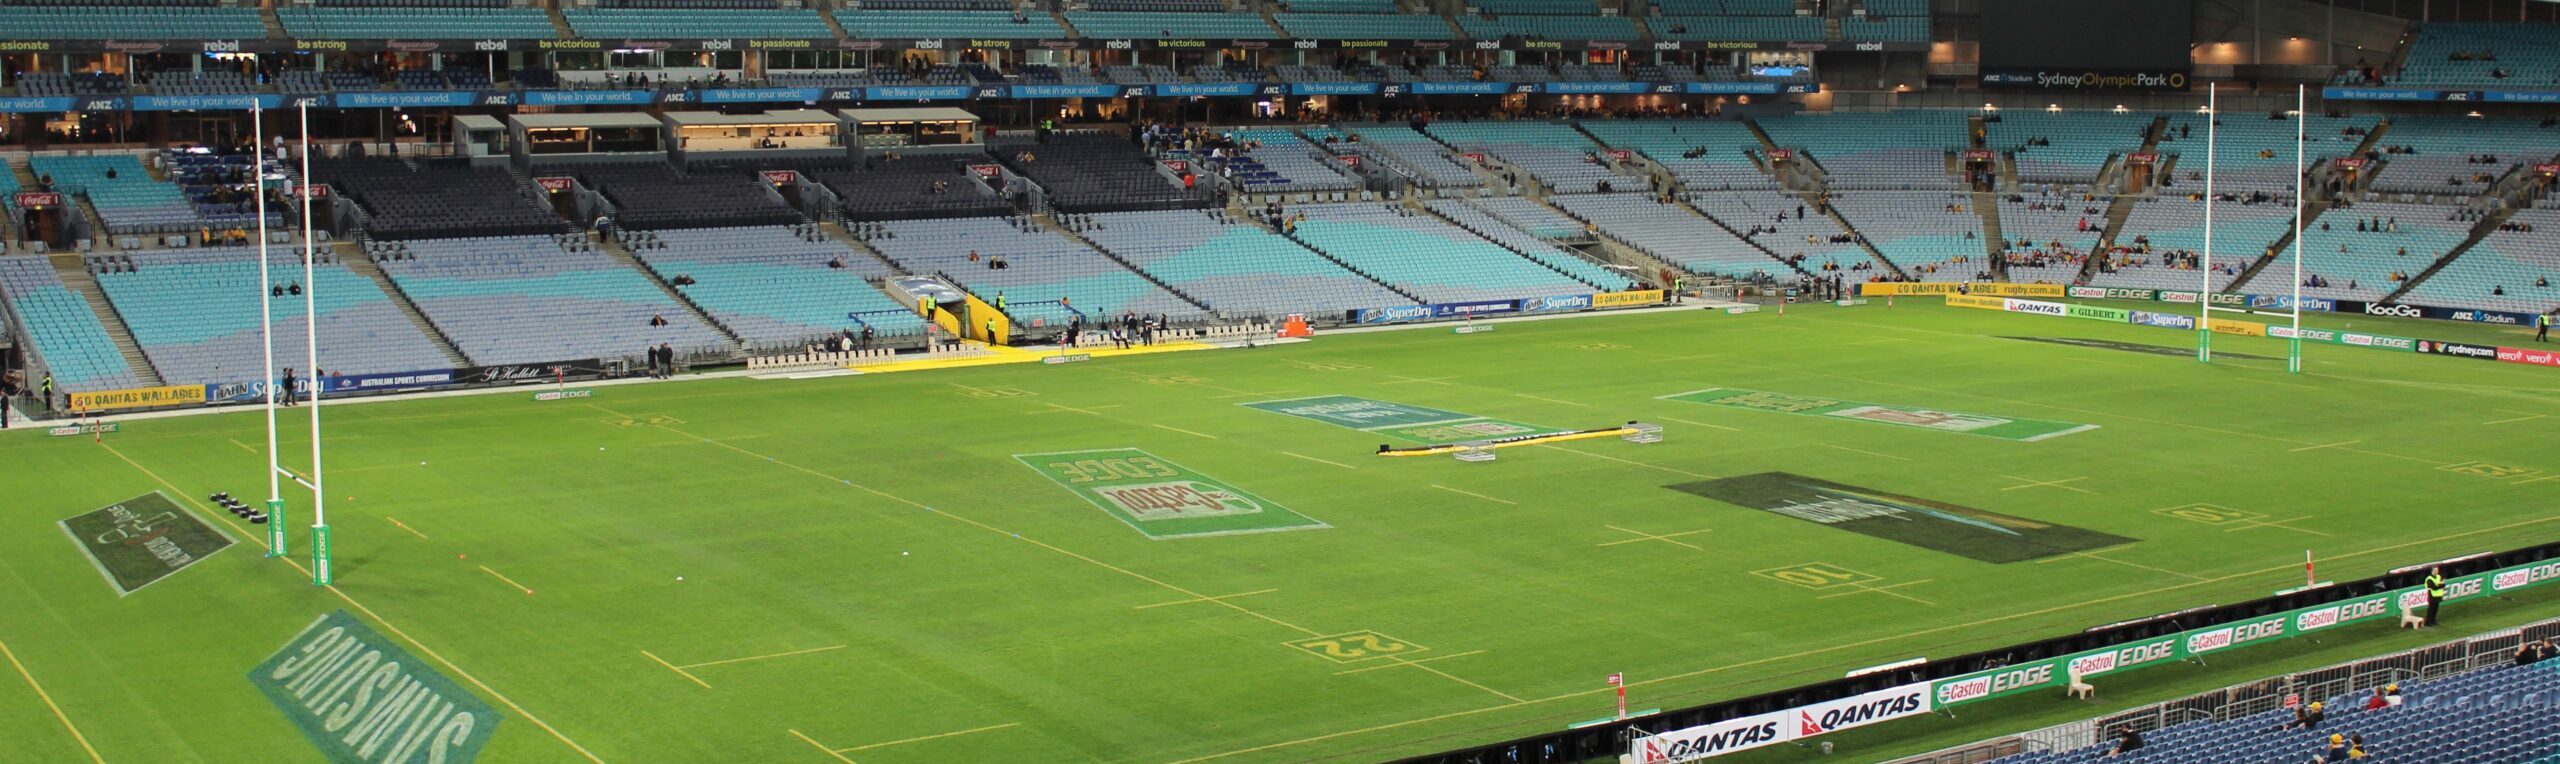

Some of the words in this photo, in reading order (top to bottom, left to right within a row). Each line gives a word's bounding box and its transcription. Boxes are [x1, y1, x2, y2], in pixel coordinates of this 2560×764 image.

[0, 41, 49, 50] ssionate
[204, 41, 239, 51] rebel
[312, 41, 346, 51] strong
[475, 39, 506, 50] rebel
[554, 40, 600, 49] victorious
[702, 39, 731, 49] rebel
[763, 40, 810, 50] passionate
[916, 39, 942, 49] rebel
[983, 40, 1009, 49] strong
[1106, 39, 1131, 48] rebel
[1294, 40, 1317, 49] rebel
[1477, 40, 1500, 49] rebel
[1655, 40, 1680, 50] rebel
[1856, 41, 1882, 50] rebel
[717, 91, 730, 99] We
[732, 91, 746, 99] live
[757, 92, 775, 101] your
[881, 88, 893, 97] We
[894, 88, 907, 97] live
[918, 89, 935, 98] your
[1025, 87, 1037, 95] We
[1038, 87, 1051, 95] live
[1060, 88, 1076, 97] your
[152, 97, 169, 107] We
[171, 97, 188, 107] live
[202, 98, 223, 108] your
[226, 96, 254, 106] world
[354, 95, 368, 104] We
[371, 95, 387, 104] live
[400, 96, 420, 105] your
[542, 93, 556, 101] We
[558, 93, 573, 102] live
[585, 94, 604, 103] your
[1912, 285, 1946, 294] QANTAS
[1948, 285, 1997, 294] WABIES
[2004, 285, 2060, 296] rugby.com.au
[2077, 289, 2104, 298] Castrol
[2107, 289, 2152, 299] EDGE
[1546, 296, 1588, 310] SuperDry
[2168, 293, 2195, 302] Castrol
[2018, 303, 2061, 314] QANTAS
[2279, 296, 2330, 311] SuerDry
[1387, 306, 1432, 320] SuperDry
[2078, 308, 2115, 319] GILBERT
[2365, 302, 2420, 318] KooGa
[2151, 315, 2193, 328] SuperDry
[2452, 310, 2473, 321] ANZ
[2483, 313, 2515, 324] Stadium
[2274, 328, 2294, 337] Castro
[2300, 330, 2333, 340] EDGE
[2374, 337, 2410, 348] EDGE
[2448, 344, 2494, 357] sydney.com
[2497, 351, 2516, 360] vero
[2526, 354, 2546, 364] vero
[361, 377, 393, 387] AUSTRALIAN
[394, 375, 415, 385] SPORTS
[416, 373, 450, 384] COMMISSION
[95, 391, 138, 406] QANTAS
[141, 388, 201, 403] WALLABIES
[1049, 457, 1178, 484] EDGE
[1105, 485, 1224, 514] Castrol
[2501, 570, 2527, 586] Castrol
[2530, 562, 2560, 583] EDG
[2407, 592, 2429, 606] Castr
[2307, 609, 2336, 627] Castrol
[2339, 597, 2389, 622] EDGE
[2198, 630, 2230, 649] Castrol
[2232, 617, 2287, 643] EDGE
[1302, 635, 1404, 657] 22
[2080, 656, 2114, 674] Castrol
[2117, 639, 2176, 667] EDGE
[1950, 680, 1988, 700] Castrol
[1992, 663, 2055, 693] EDGE
[272, 626, 475, 764] SAMSUNG
[1820, 692, 1921, 730] QANTAS
[1667, 721, 1777, 761] QANTAS
